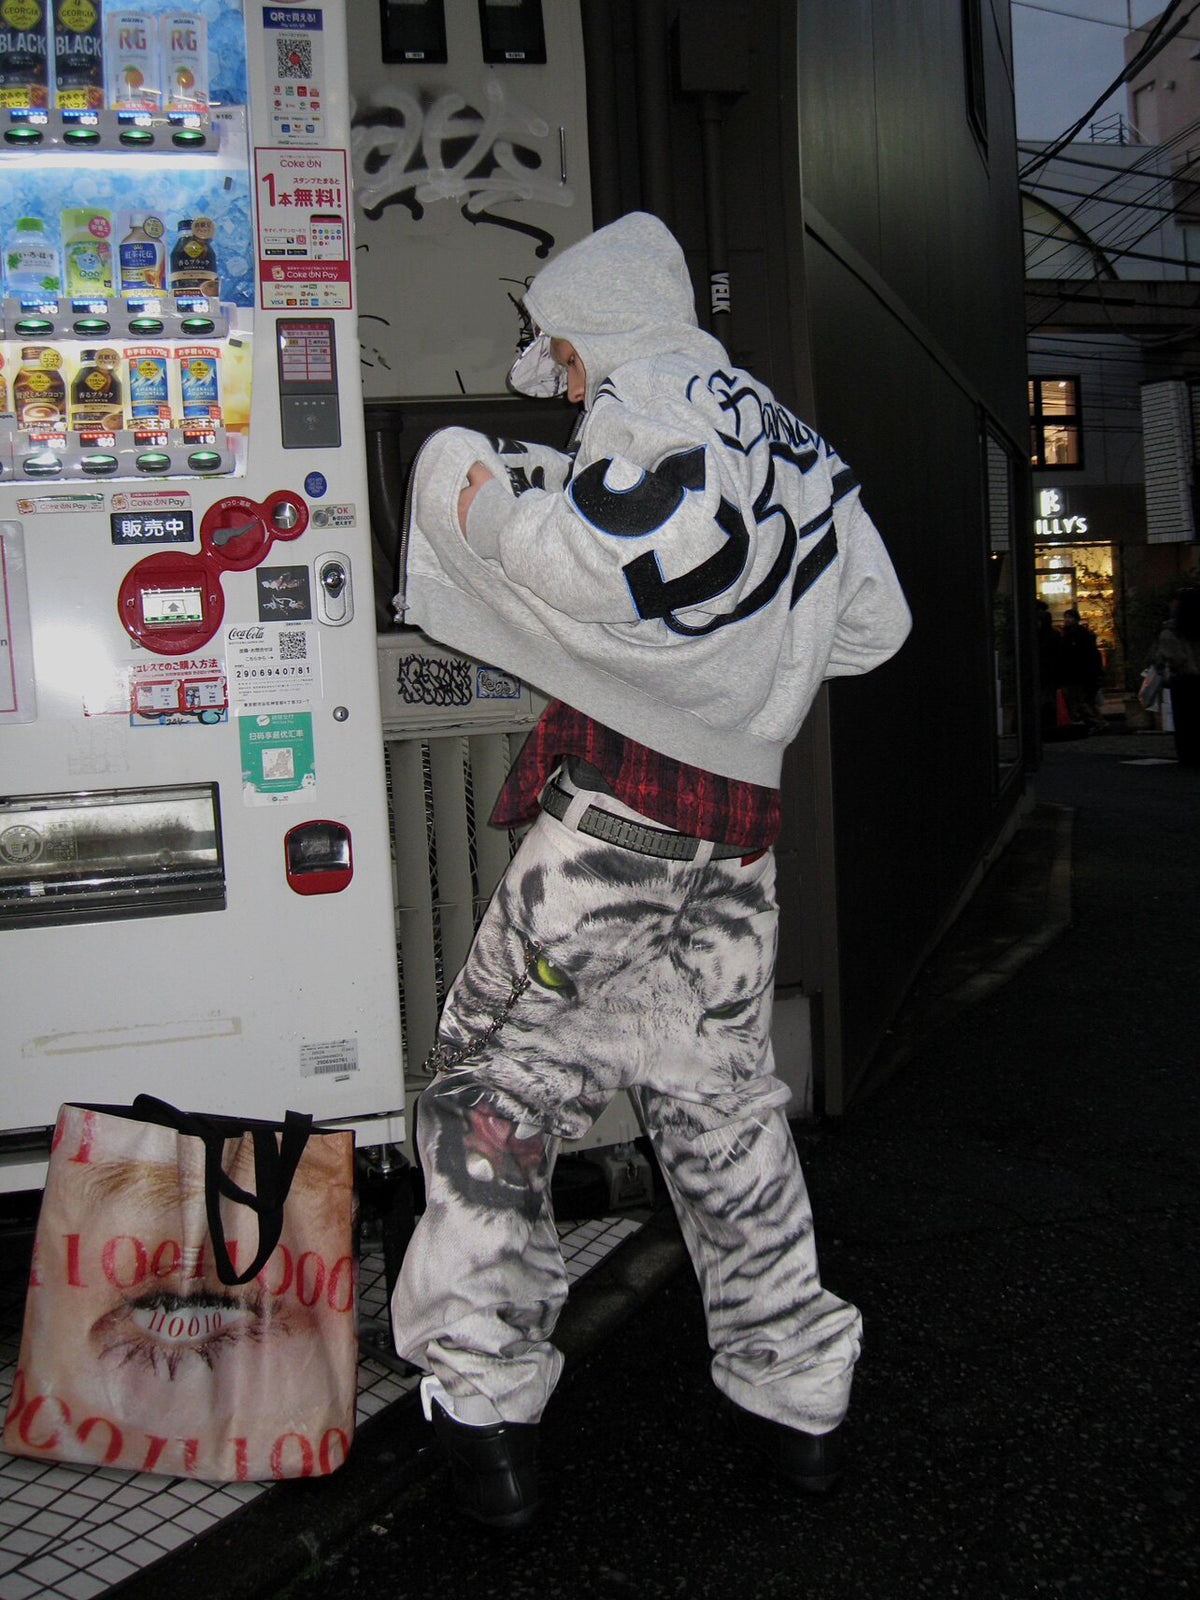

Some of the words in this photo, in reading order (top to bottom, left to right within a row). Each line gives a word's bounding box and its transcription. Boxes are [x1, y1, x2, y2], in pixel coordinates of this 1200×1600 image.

[4, 6, 38, 15] GEORGIA
[61, 8, 94, 17] GEORGIA
[0, 33, 46, 55] BLACK
[56, 35, 101, 56] BLACK
[280, 160, 305, 168] Coke
[293, 177, 341, 185] スタンプたまると
[322, 272, 338, 280] Pay
[73, 502, 86, 510] Pay
[131, 499, 153, 507] Coke
[168, 498, 185, 507] Pay
[121, 518, 184, 537] 販売中
[236, 667, 310, 678] 2906940781
[148, 1311, 222, 1338] 110010
